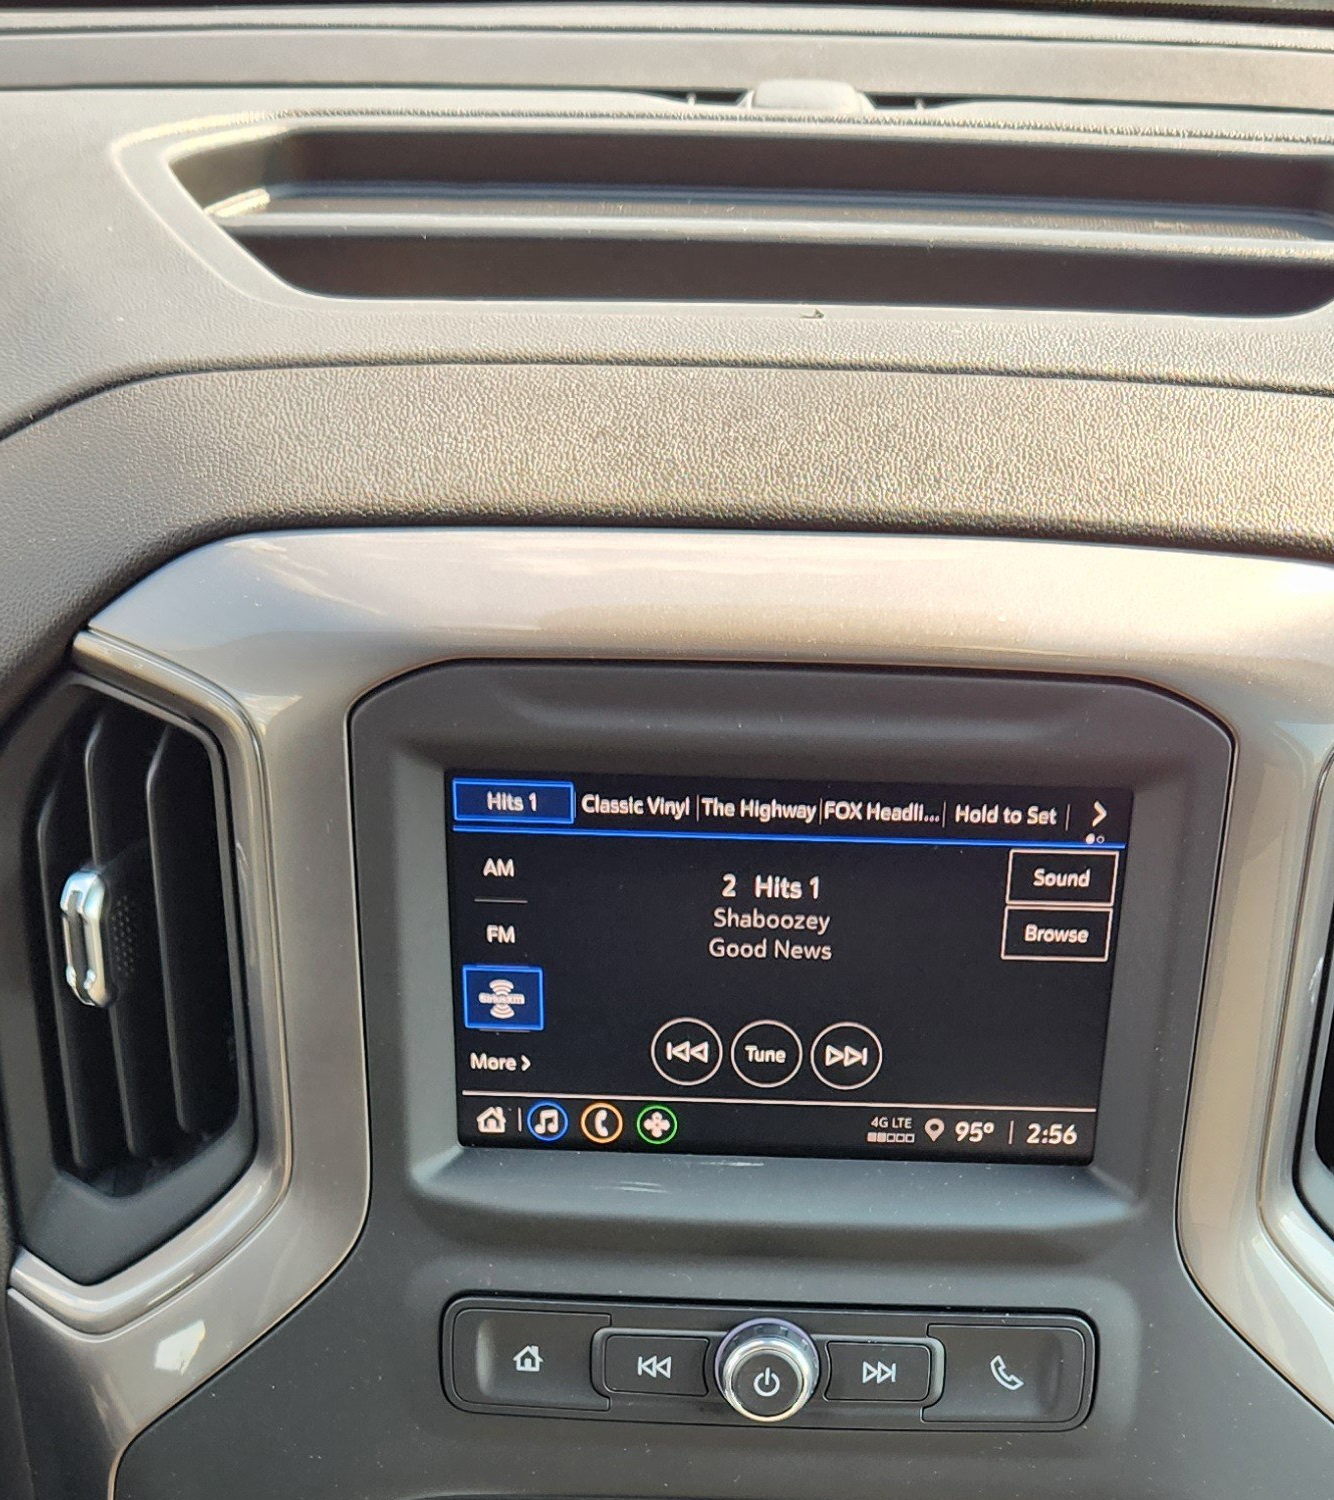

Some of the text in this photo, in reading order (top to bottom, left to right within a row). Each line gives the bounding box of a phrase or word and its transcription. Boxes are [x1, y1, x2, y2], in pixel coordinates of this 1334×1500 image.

[487, 792, 538, 812] Hits 1
[581, 794, 690, 820] Classic Vinyl
[701, 798, 817, 823] The Highway
[824, 801, 863, 821] FOX
[955, 804, 1058, 826] Hold to Set
[483, 858, 515, 878] AM
[1033, 868, 1091, 888] Sound
[722, 873, 820, 900] 2 Hits 1
[713, 906, 831, 936] Shaboozey
[486, 925, 516, 944] FM
[1024, 924, 1090, 944] Browse
[709, 937, 833, 960] Good News
[470, 1053, 517, 1072] More
[744, 1045, 786, 1064] Tune
[871, 1117, 913, 1130] 4G LTE
[1026, 1123, 1078, 1145] 2:56
